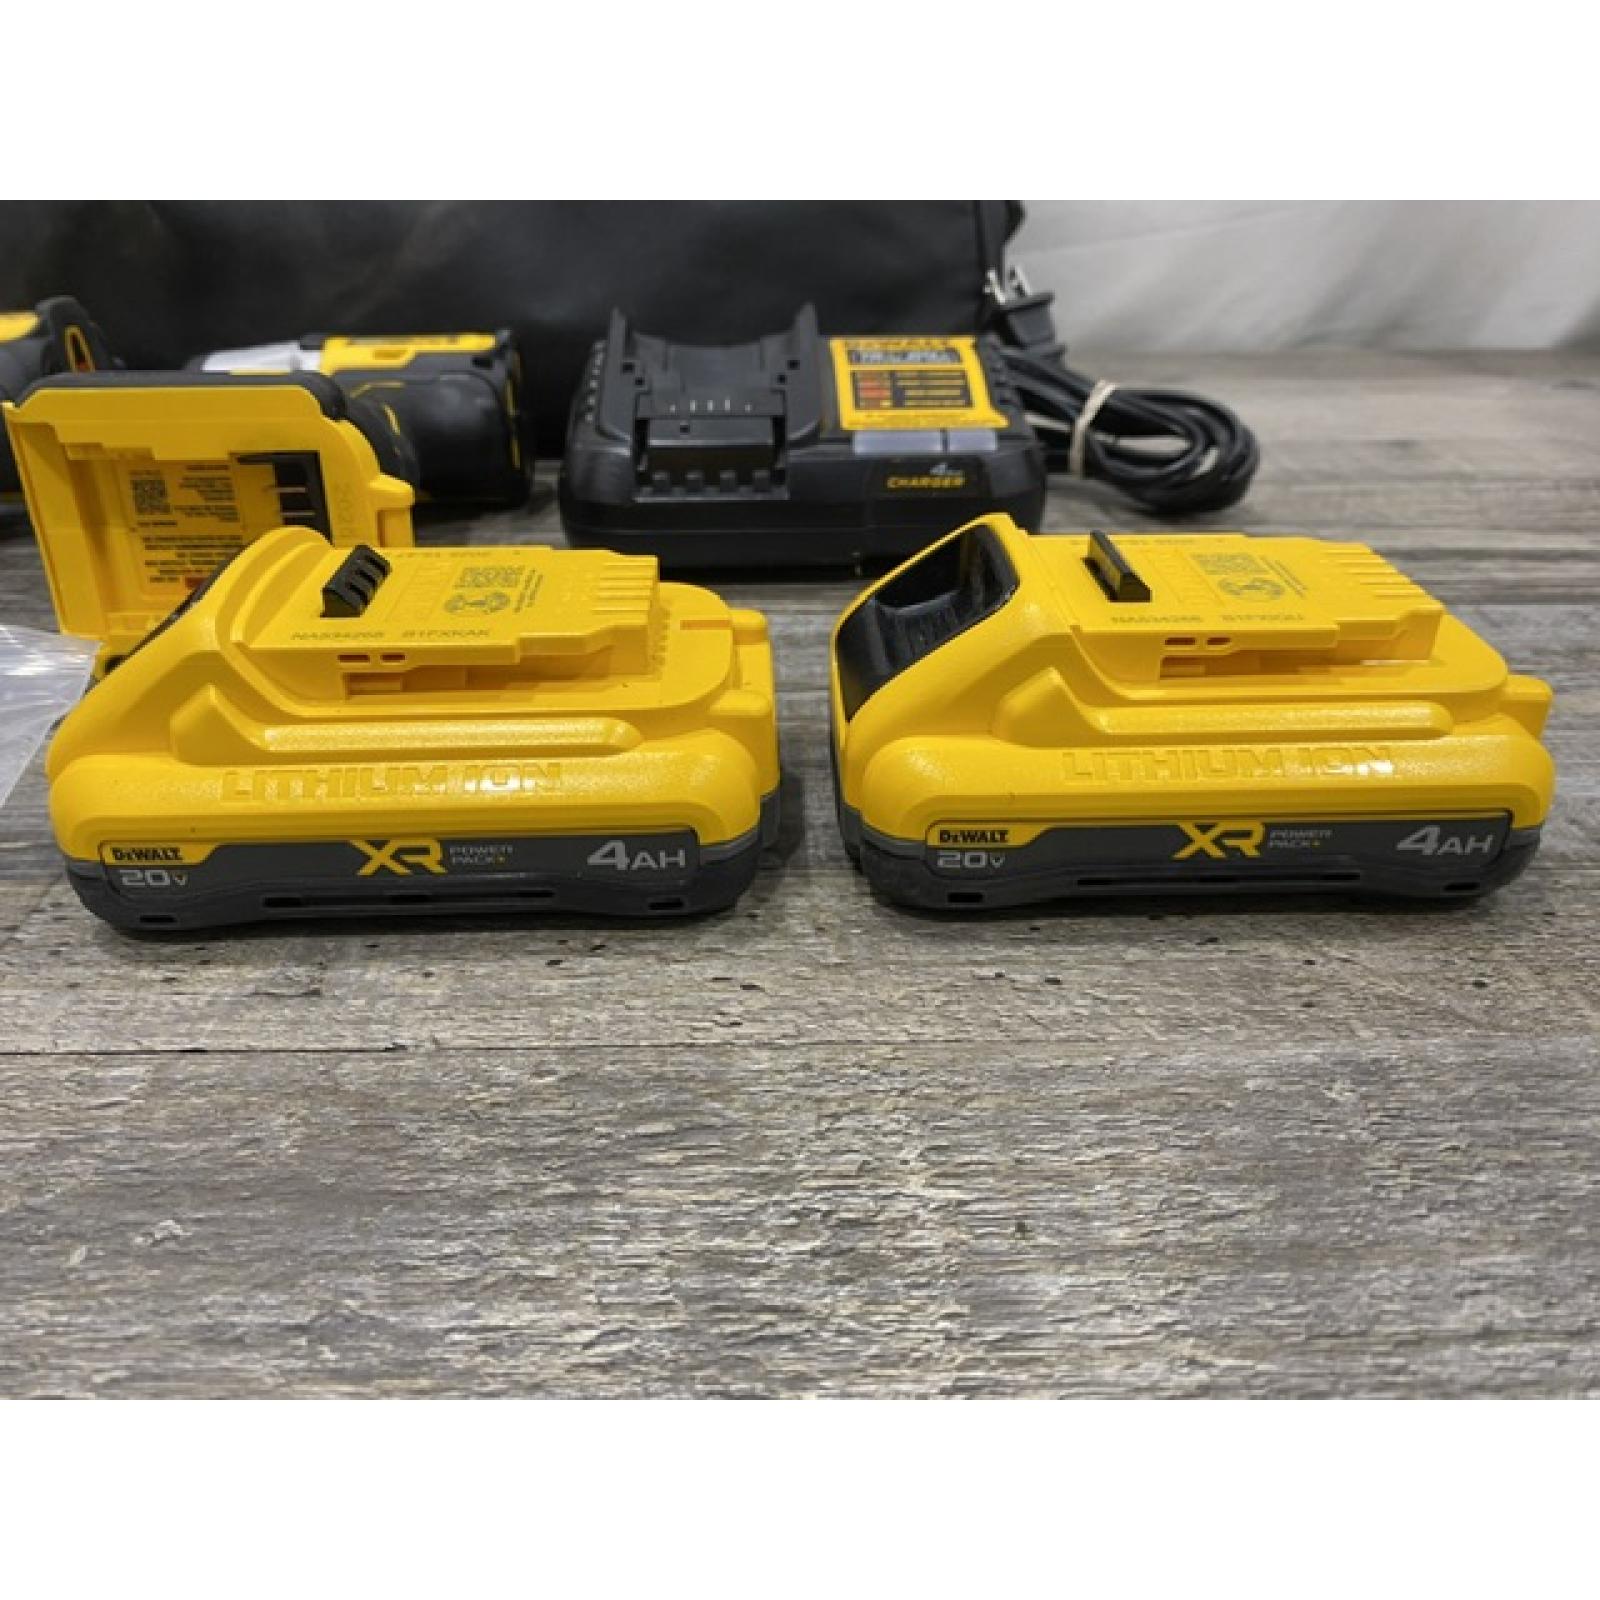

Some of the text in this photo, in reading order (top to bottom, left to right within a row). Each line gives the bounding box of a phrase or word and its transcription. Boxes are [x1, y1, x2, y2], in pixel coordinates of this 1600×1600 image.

[887, 475, 965, 488] CHARGER
[222, 762, 562, 802] LITHIUM ION
[1061, 746, 1396, 783] LITHIUM ION
[450, 844, 514, 855] POWER
[1172, 820, 1266, 861] XR
[1270, 829, 1333, 839] POWER
[351, 839, 449, 876] XR
